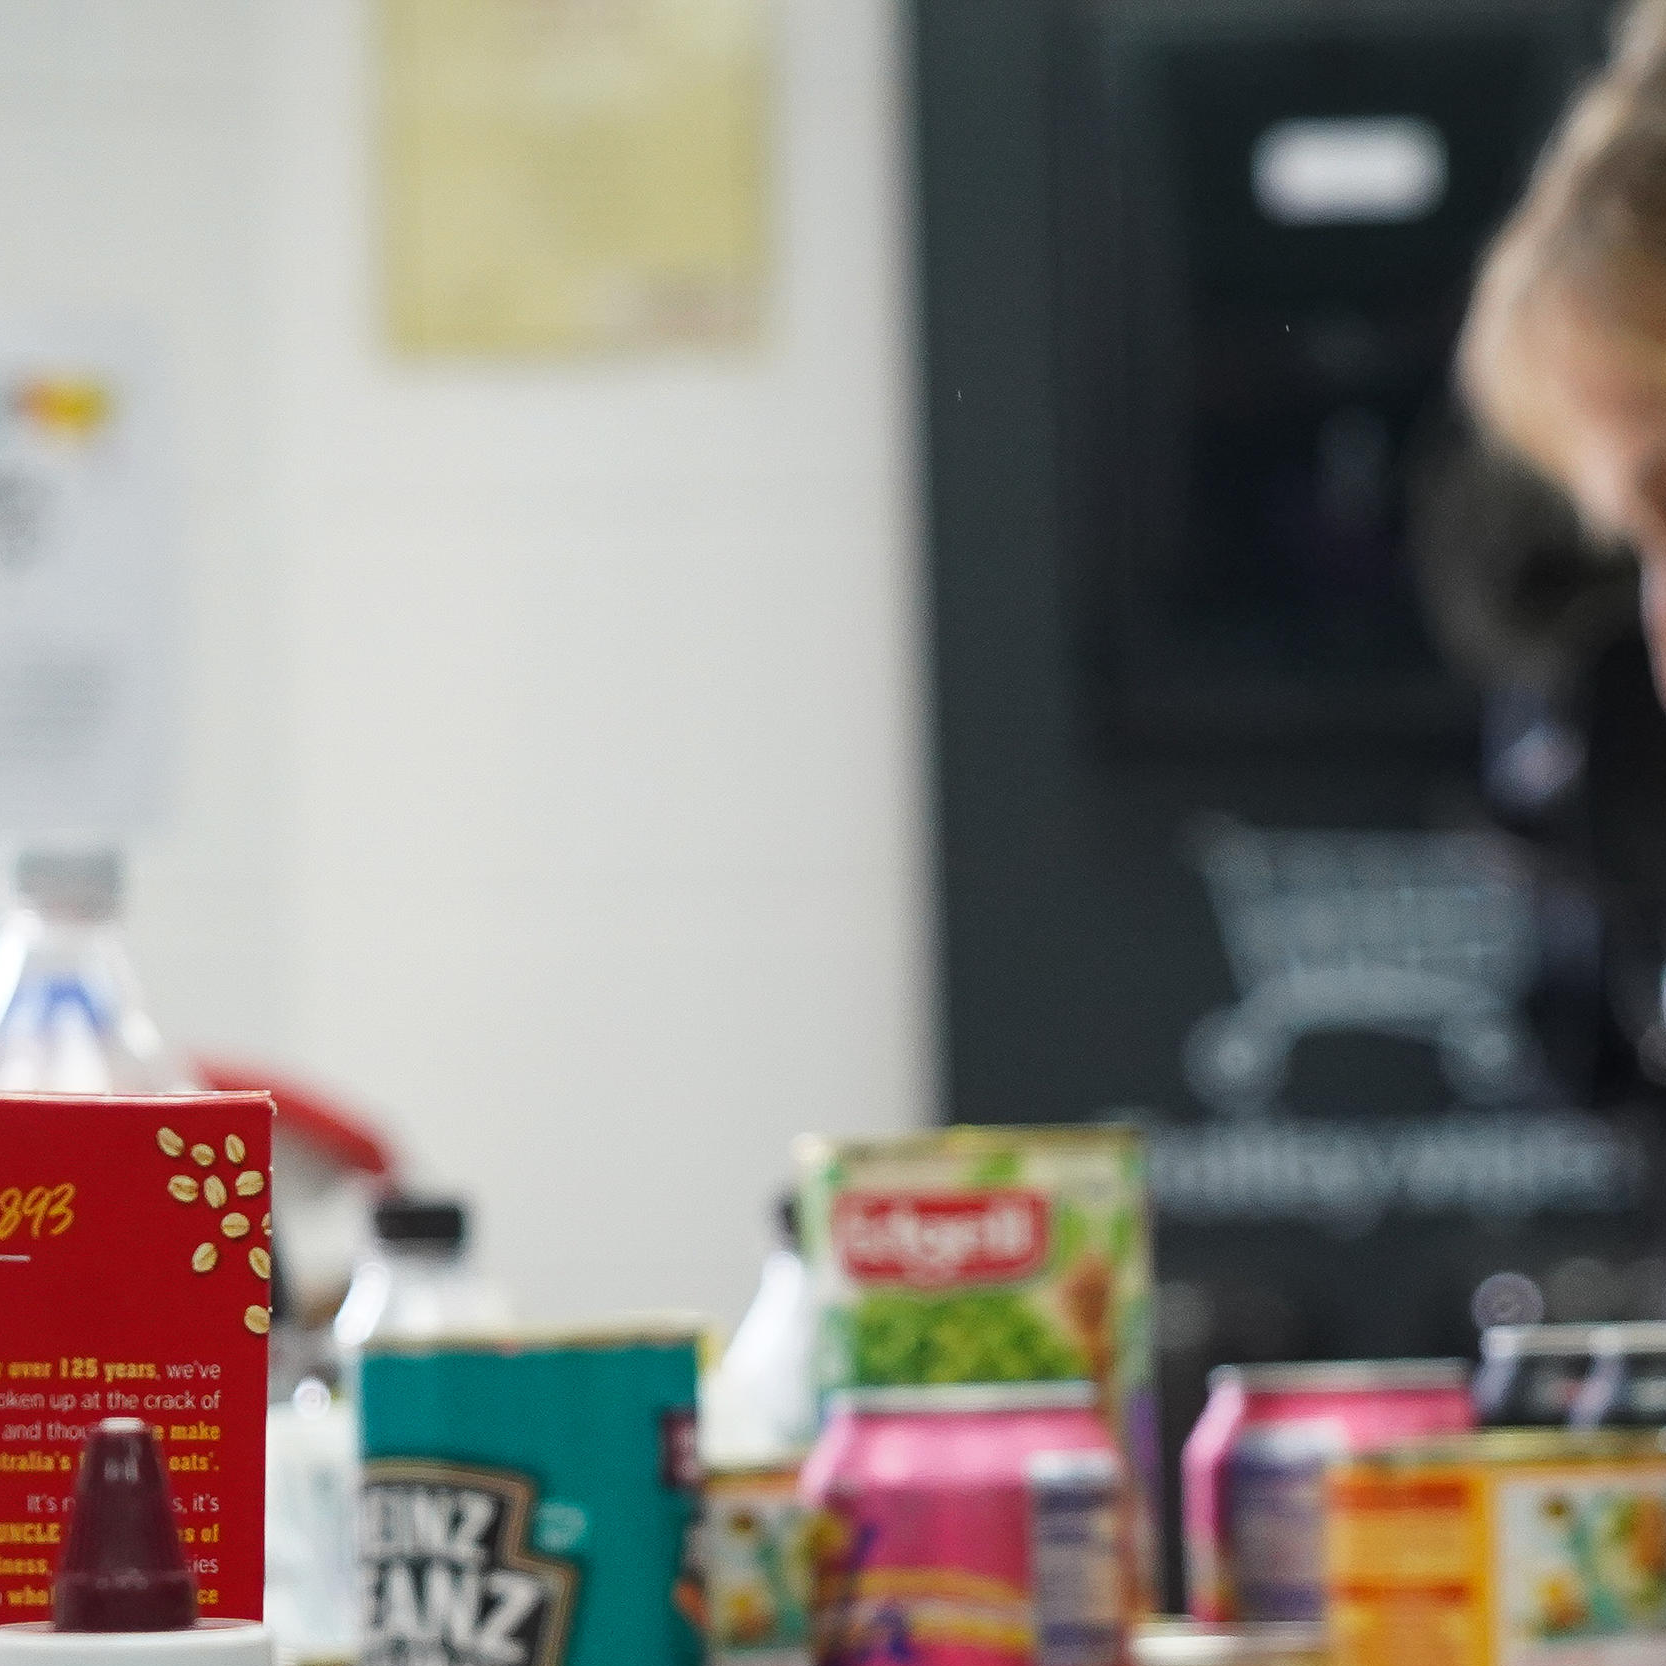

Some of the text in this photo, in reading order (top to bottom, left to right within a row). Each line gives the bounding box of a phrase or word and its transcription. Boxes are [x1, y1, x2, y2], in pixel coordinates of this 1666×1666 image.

[8, 1361, 52, 1379] over
[59, 1357, 98, 1379] 125
[166, 1361, 222, 1379] we've
[49, 1396, 77, 1413] up
[81, 1393, 102, 1410] at
[107, 1391, 139, 1410] the
[143, 1391, 197, 1410] crack
[201, 1390, 222, 1410] of
[2, 1421, 42, 1441] and
[169, 1421, 222, 1441] make
[26, 1494, 58, 1513] It's
[192, 1494, 221, 1513] it's
[361, 1487, 494, 1557] EINZ
[201, 1523, 221, 1543] of
